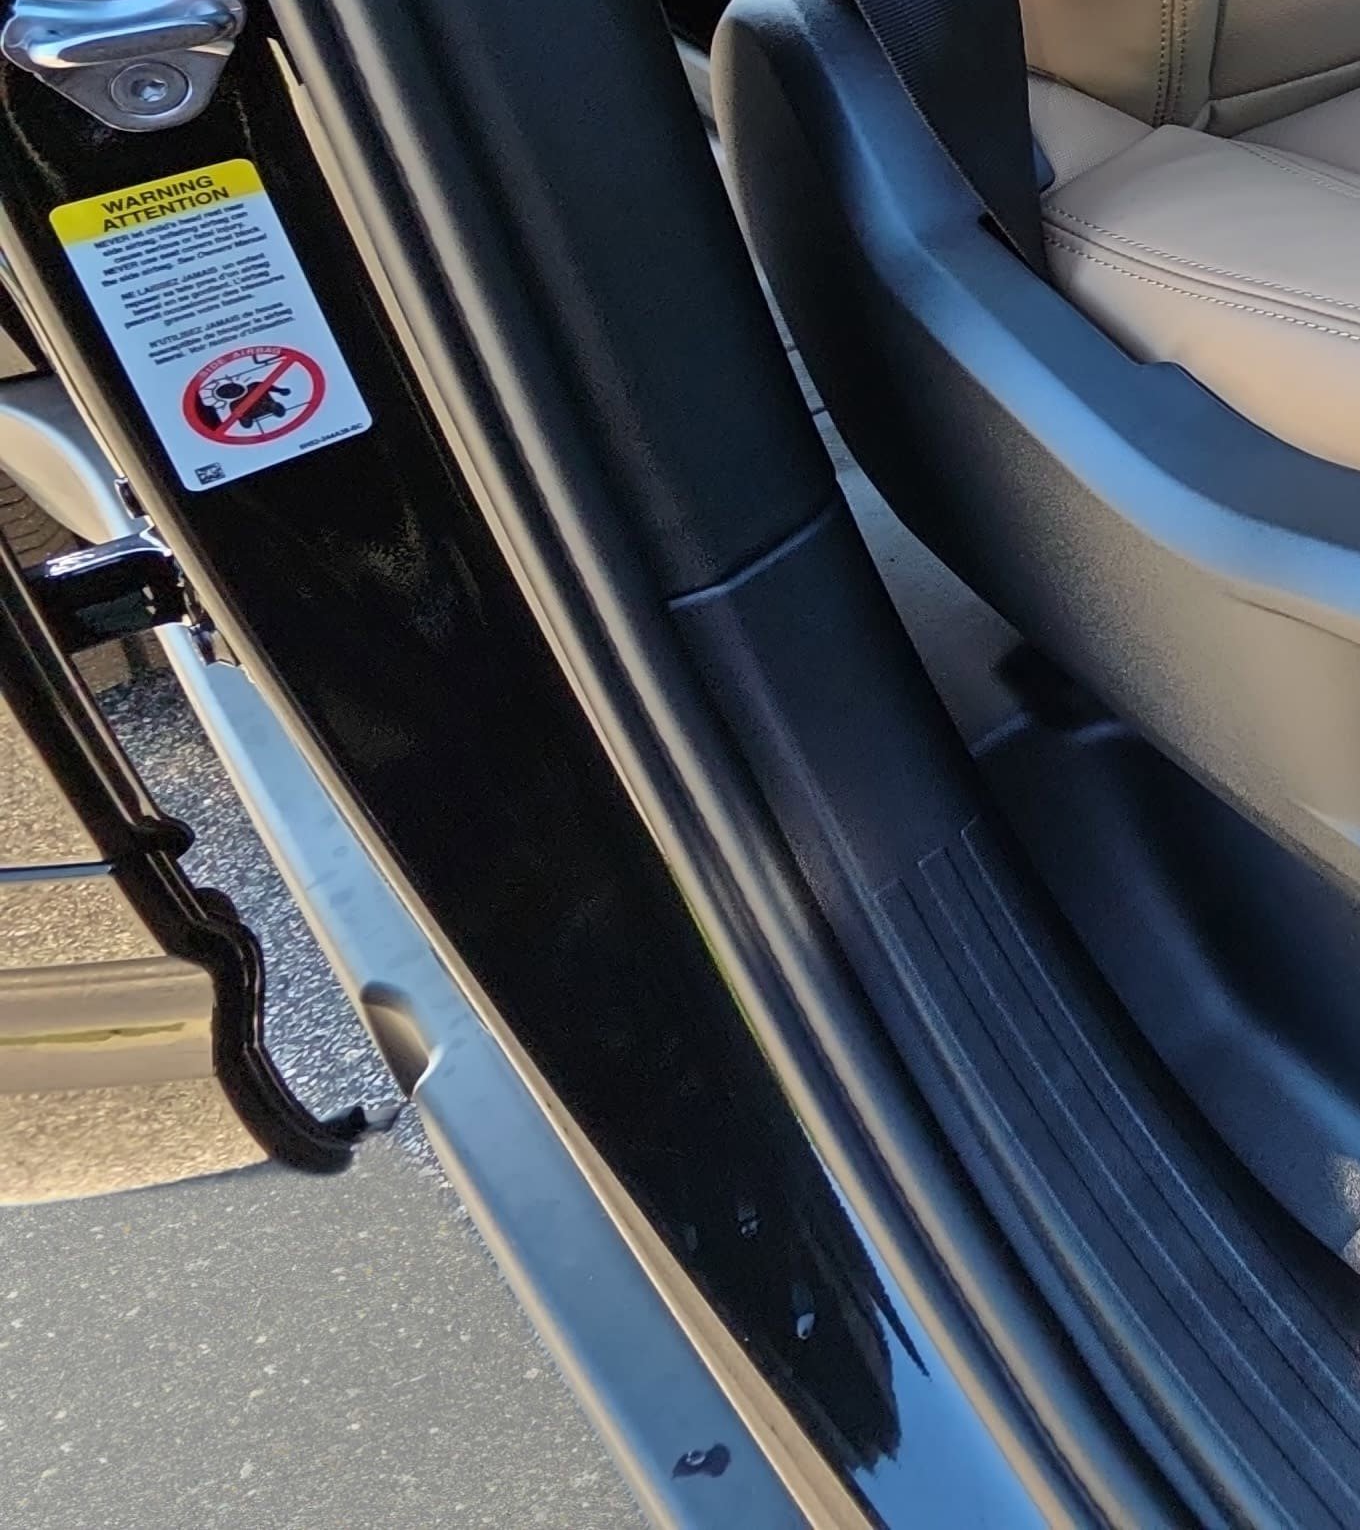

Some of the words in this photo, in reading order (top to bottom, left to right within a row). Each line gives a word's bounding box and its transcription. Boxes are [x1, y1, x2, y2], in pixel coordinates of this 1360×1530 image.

[101, 175, 213, 213] WARNING
[104, 186, 229, 231] ATTENTION
[94, 234, 129, 248] NEVER
[103, 247, 123, 256] side
[199, 217, 229, 228] airbag
[230, 211, 247, 219] can
[103, 261, 138, 275] NEVER
[140, 257, 157, 265] use
[159, 249, 179, 259] seat
[181, 240, 212, 252] covers
[114, 251, 142, 263] cause
[144, 240, 180, 254] serious
[119, 272, 139, 281] side
[241, 261, 270, 273] airbag
[121, 291, 135, 299] NE
[181, 266, 217, 282] JAMAIS
[205, 314, 240, 330] JAMAIS
[263, 308, 292, 320] airbag
[232, 346, 280, 359] AIRBAG
